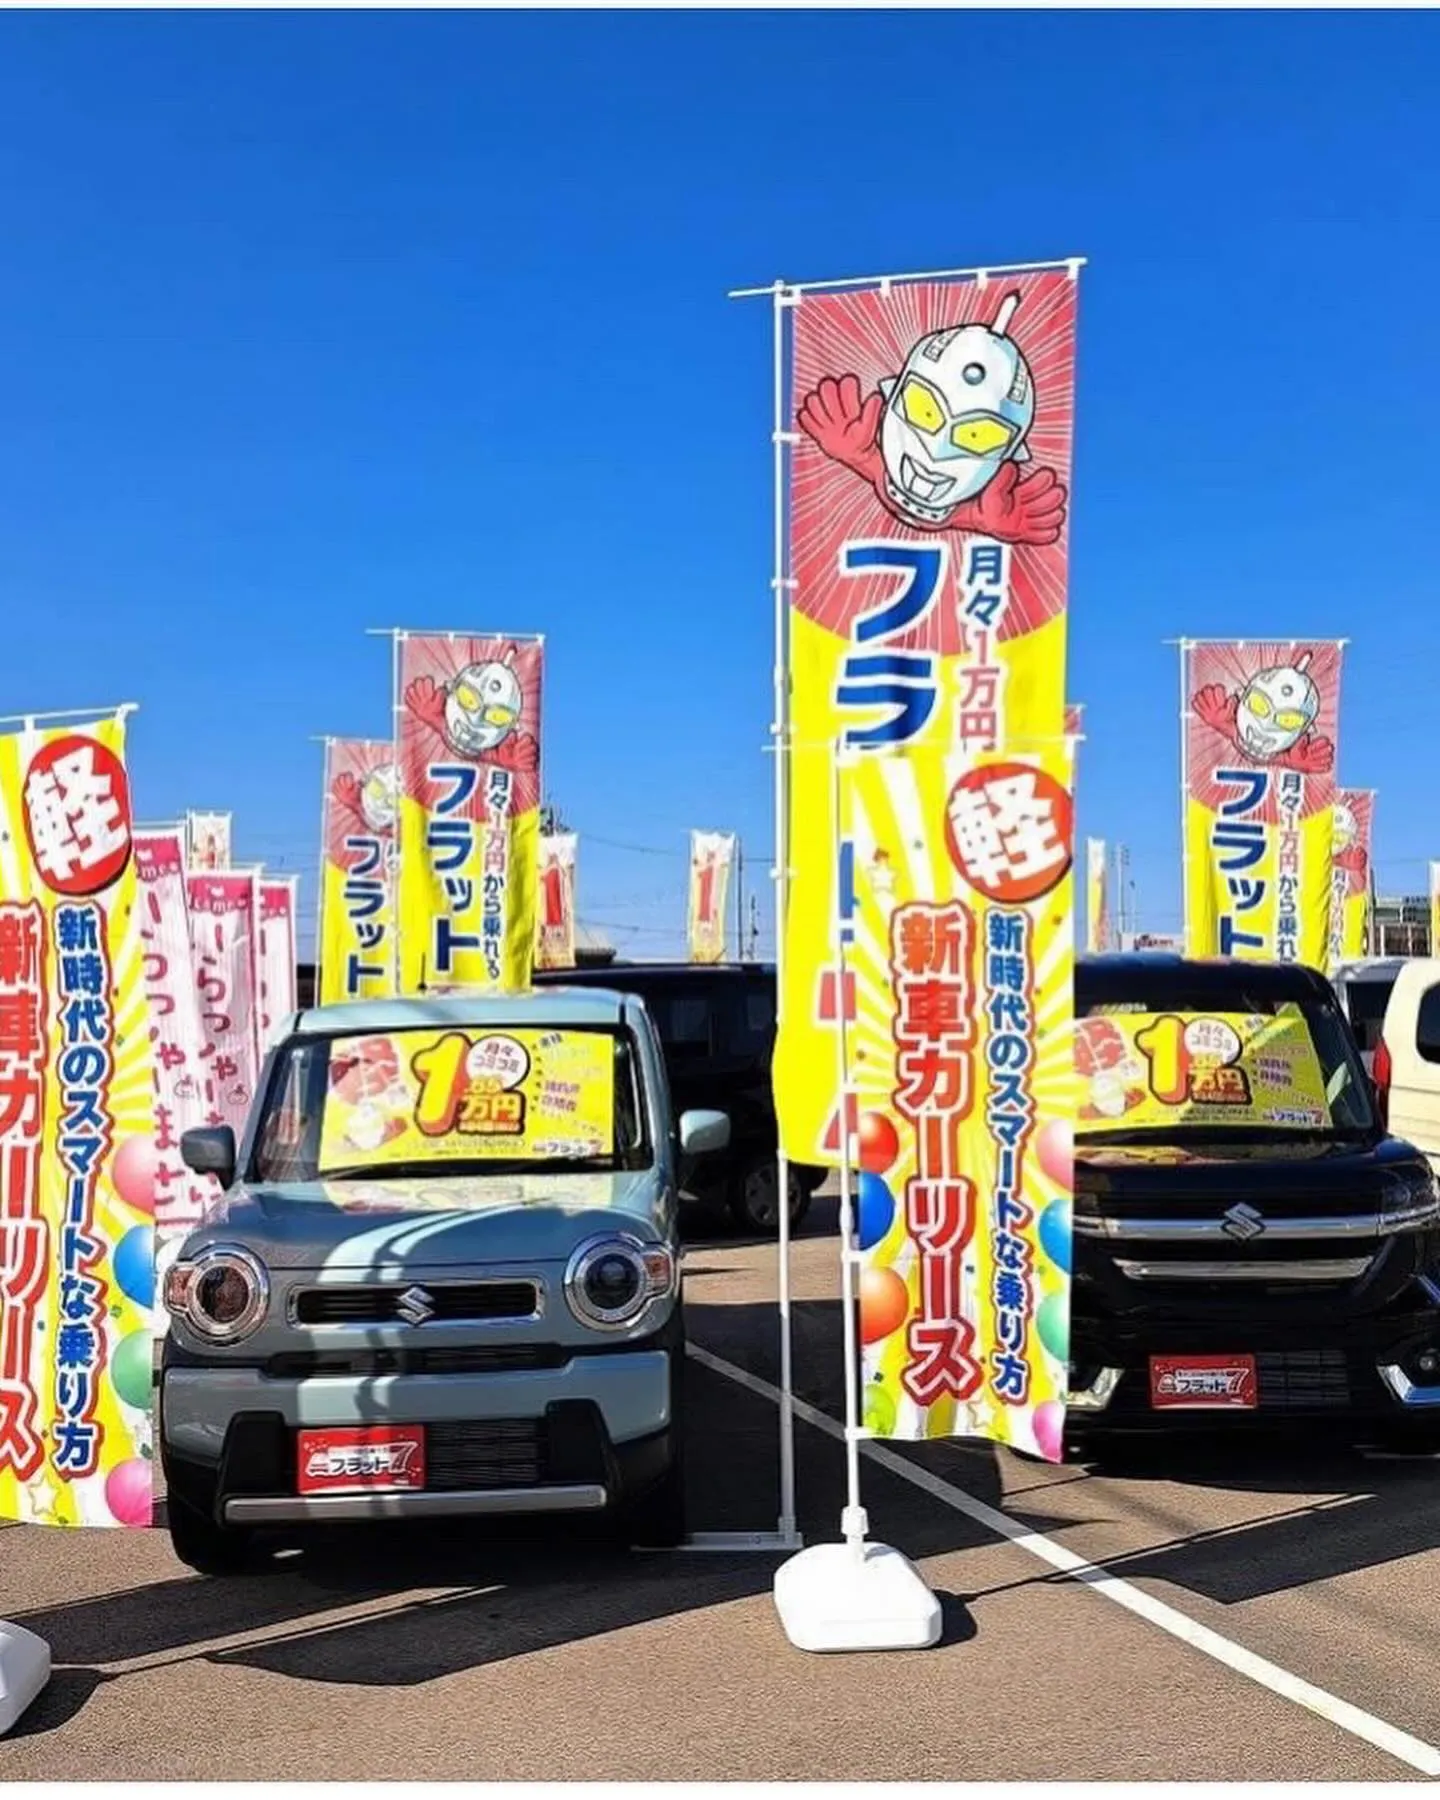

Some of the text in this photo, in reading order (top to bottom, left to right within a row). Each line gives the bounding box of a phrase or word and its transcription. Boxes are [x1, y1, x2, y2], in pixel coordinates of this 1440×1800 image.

[836, 545, 942, 744] フラ
[25, 745, 128, 882] 軽
[427, 767, 481, 972] フラット
[949, 773, 1067, 887] 軽
[1212, 770, 1268, 956] フラット
[1276, 773, 1302, 964] 月々1万円から乗れ
[344, 838, 387, 993] フラット
[54, 906, 108, 1468] 新時代のスマートな乗り方
[898, 909, 974, 1398] 新車カーリース
[986, 913, 1032, 1394] 新時代のスマートな乗り方
